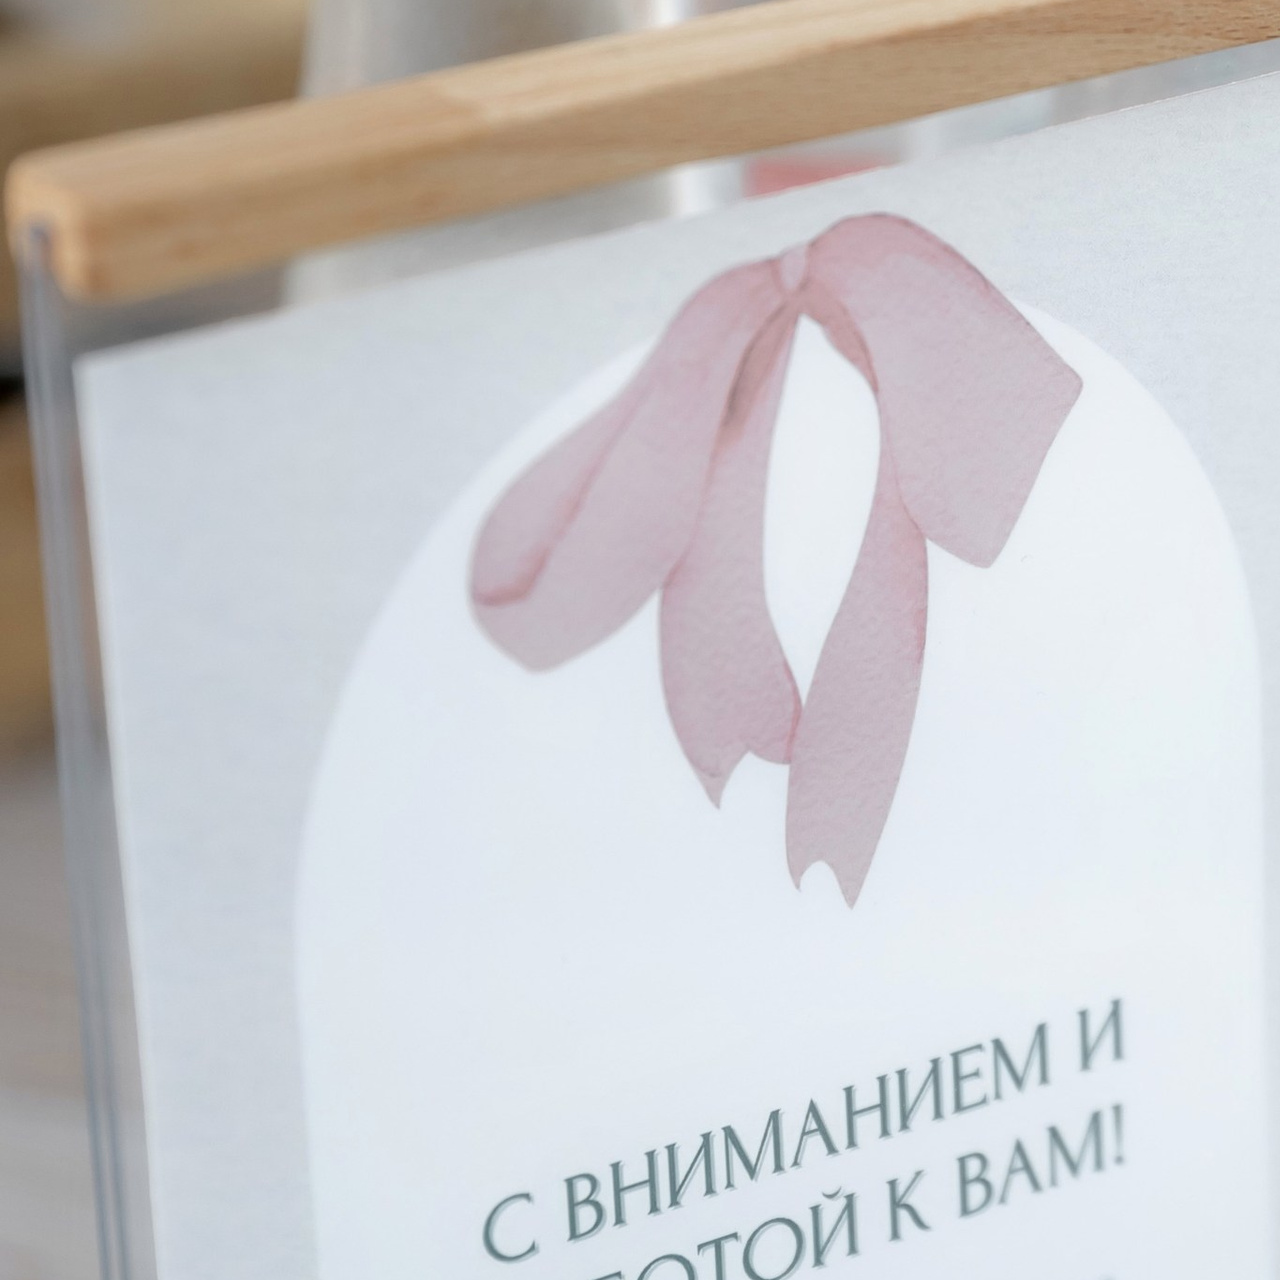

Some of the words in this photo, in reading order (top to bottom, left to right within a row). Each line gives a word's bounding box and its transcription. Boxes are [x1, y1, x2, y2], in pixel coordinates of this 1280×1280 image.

[482, 1192, 539, 1264] С
[563, 1022, 1050, 1242] ВНИМАНИЕМ
[1077, 998, 1124, 1072] И
[886, 1170, 931, 1242] К
[956, 1103, 1125, 1218] ВАМ!
